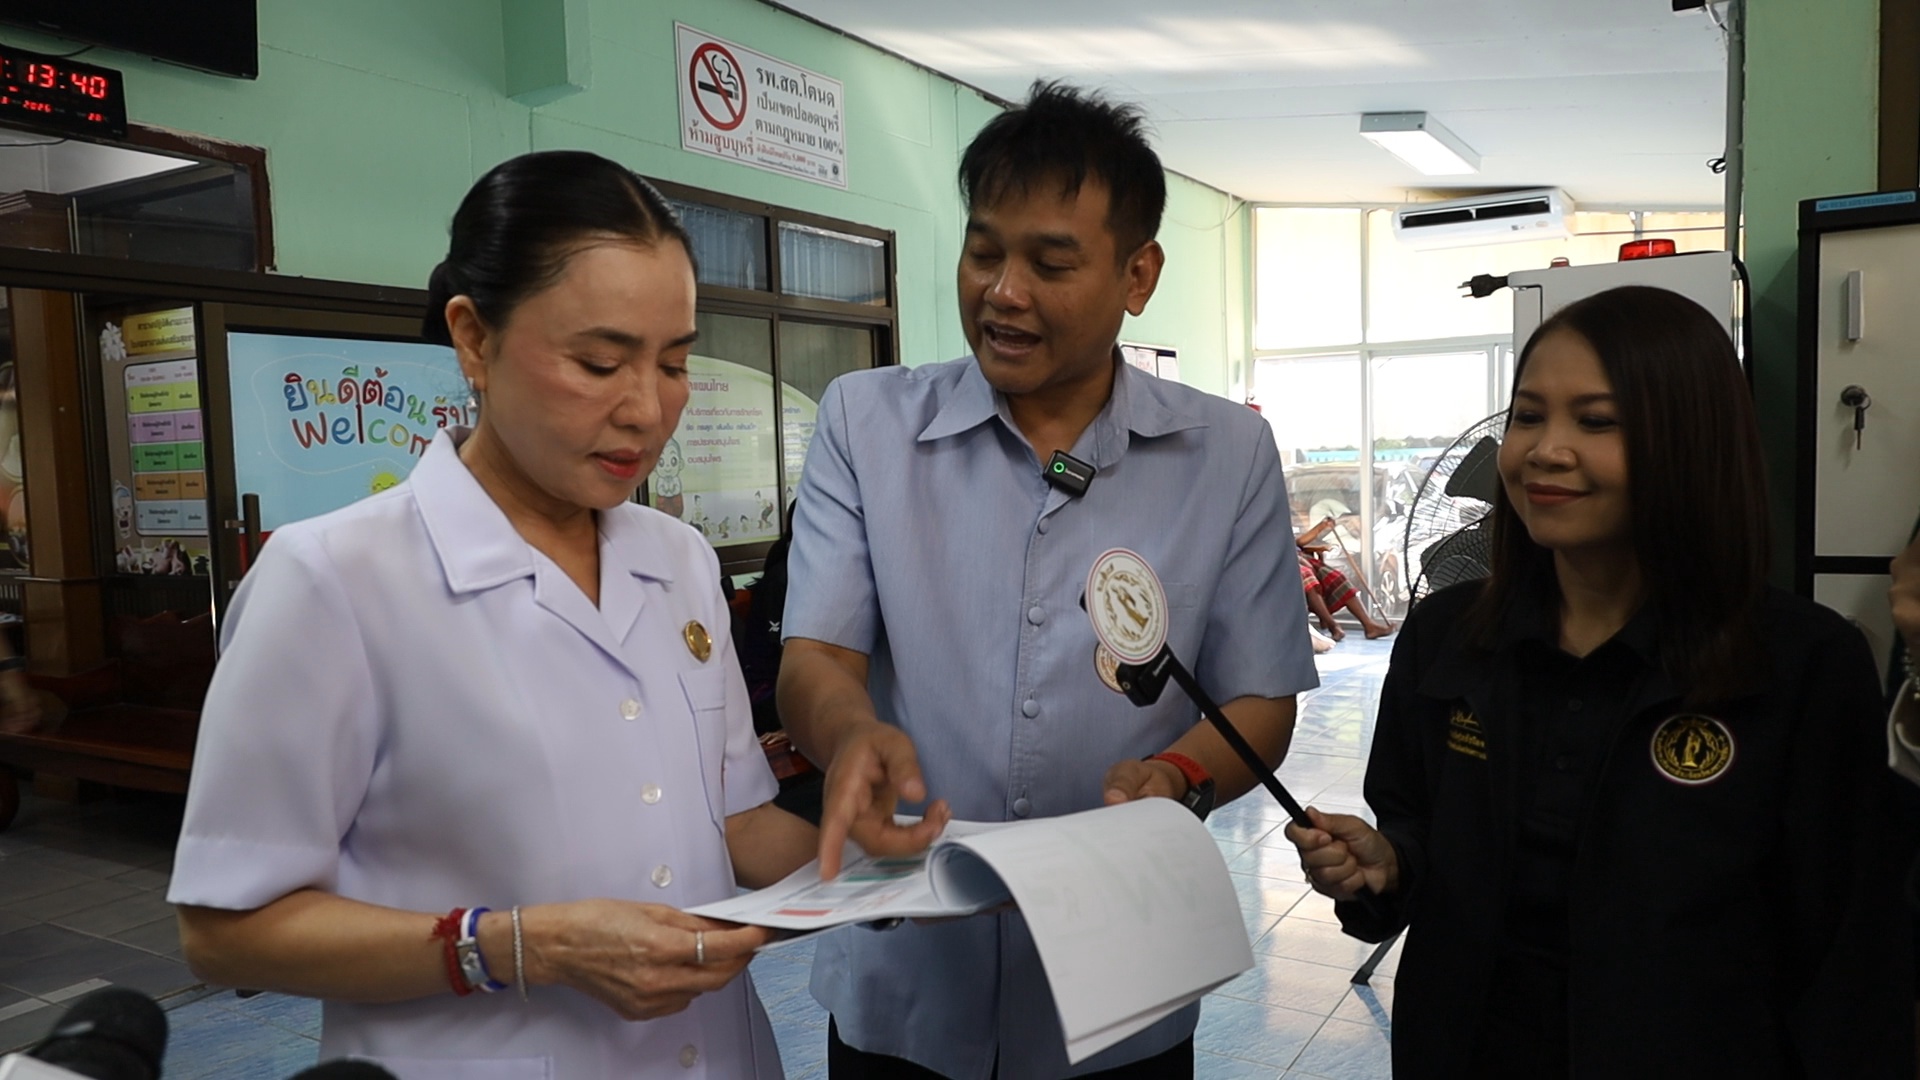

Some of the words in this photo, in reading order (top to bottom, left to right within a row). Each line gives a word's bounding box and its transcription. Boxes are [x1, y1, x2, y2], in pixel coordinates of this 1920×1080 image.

[756, 67, 835, 108] รพ.สต.โตนด
[757, 91, 839, 134] เป็นเขตปลอดบุหรี่
[689, 119, 754, 157] ห้ามสูบบุหรี่
[756, 118, 815, 146] ตามกฎหมาย
[818, 136, 843, 155] 100%
[292, 412, 432, 457] Welcom
